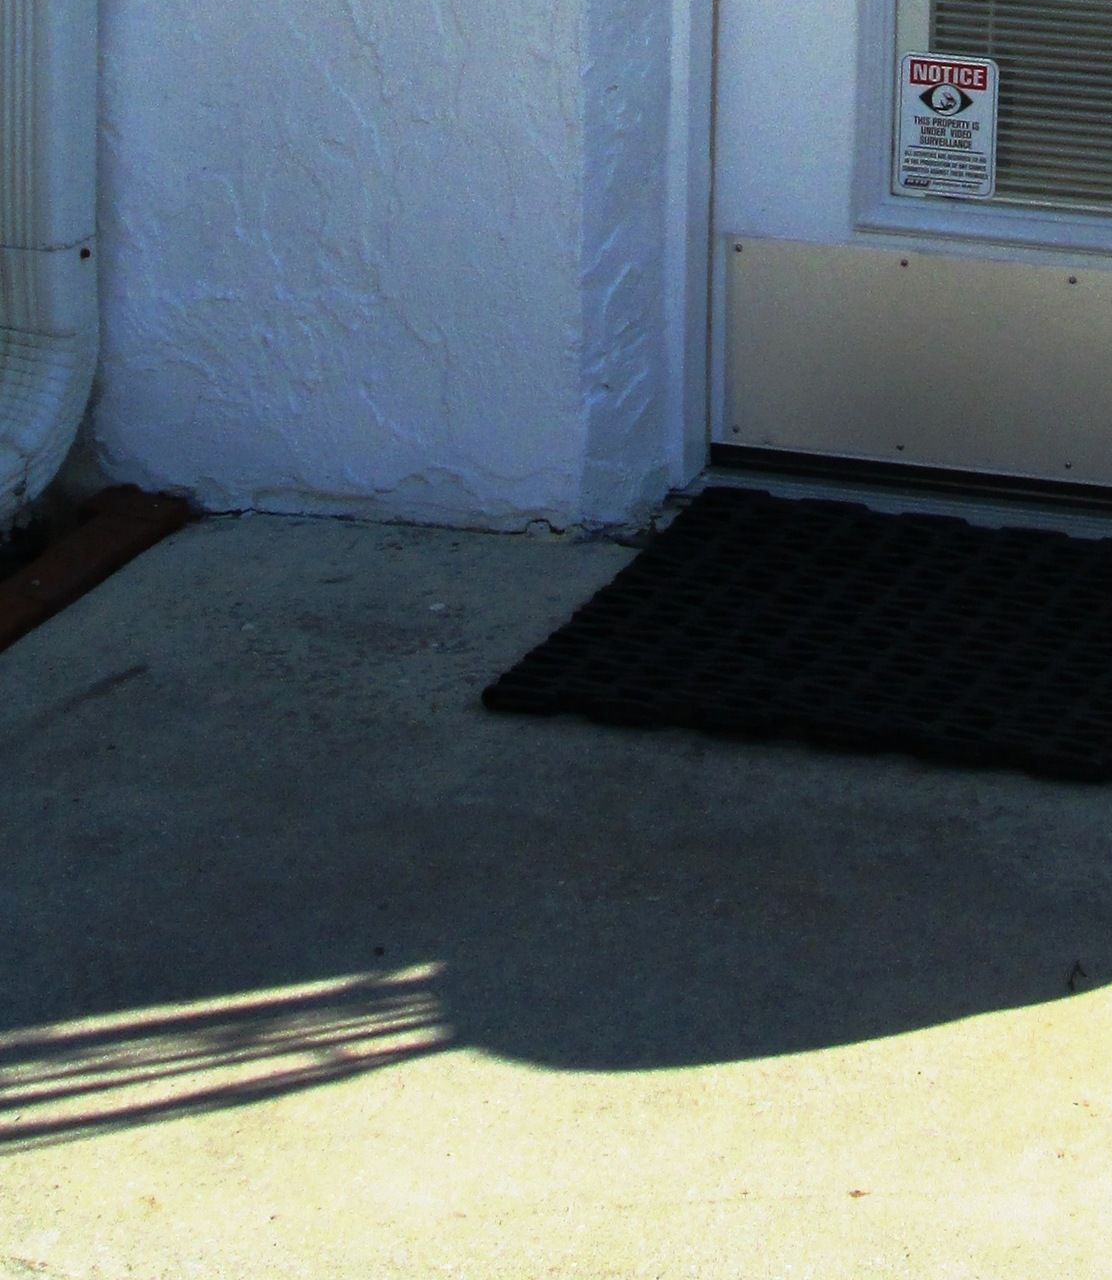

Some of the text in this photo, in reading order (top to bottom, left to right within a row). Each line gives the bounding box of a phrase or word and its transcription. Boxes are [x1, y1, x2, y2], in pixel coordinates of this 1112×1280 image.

[913, 64, 984, 87] NOTICE
[914, 116, 980, 130] THIS PROPERTY IS
[921, 126, 972, 139] UNDER VIDEO
[919, 136, 972, 149] SURVEILLANCE
